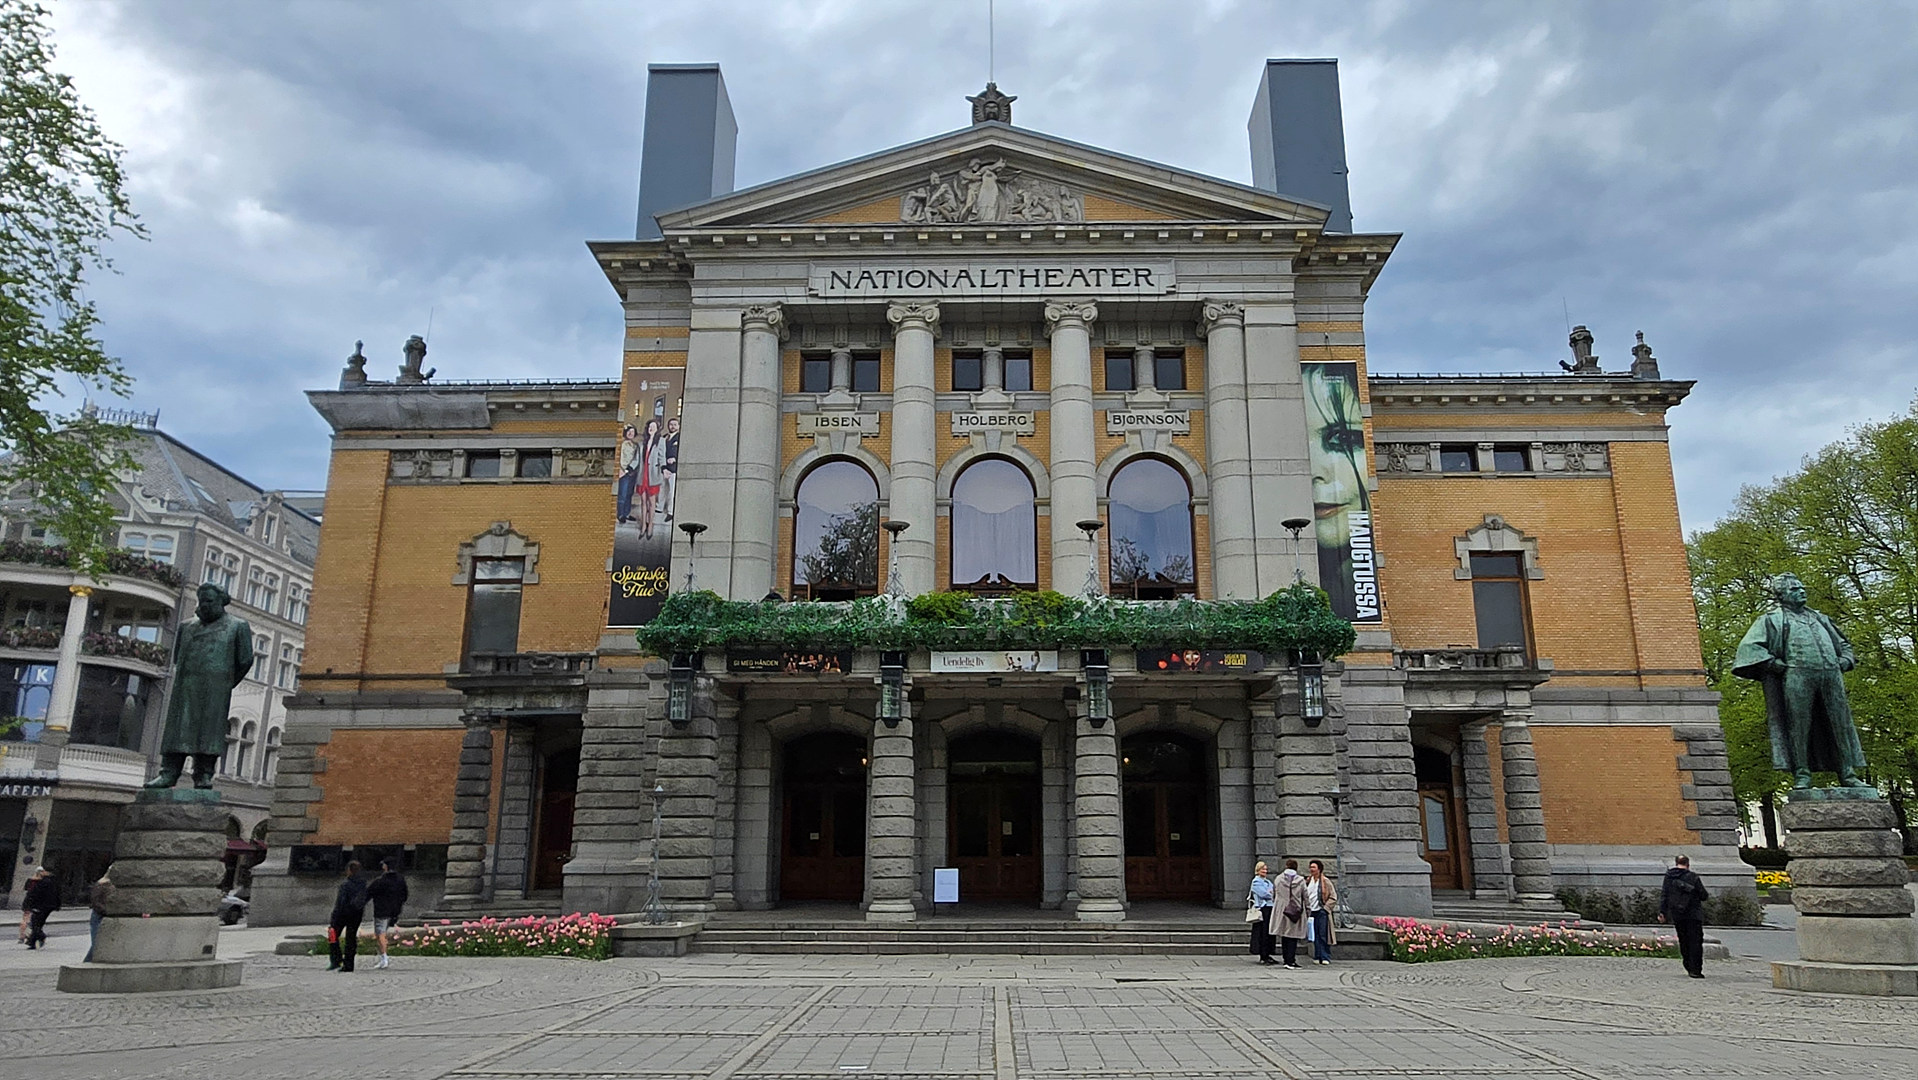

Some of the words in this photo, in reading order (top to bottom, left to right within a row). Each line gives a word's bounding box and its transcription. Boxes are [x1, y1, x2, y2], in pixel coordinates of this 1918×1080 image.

[829, 268, 1155, 290] NATIONALTHEATER
[815, 416, 862, 427] IBSEN
[959, 415, 1028, 426] HOLBERG
[1347, 510, 1379, 619] HAUGTUSSA
[611, 565, 668, 590] Spanske
[0, 784, 51, 797] AFEEN
